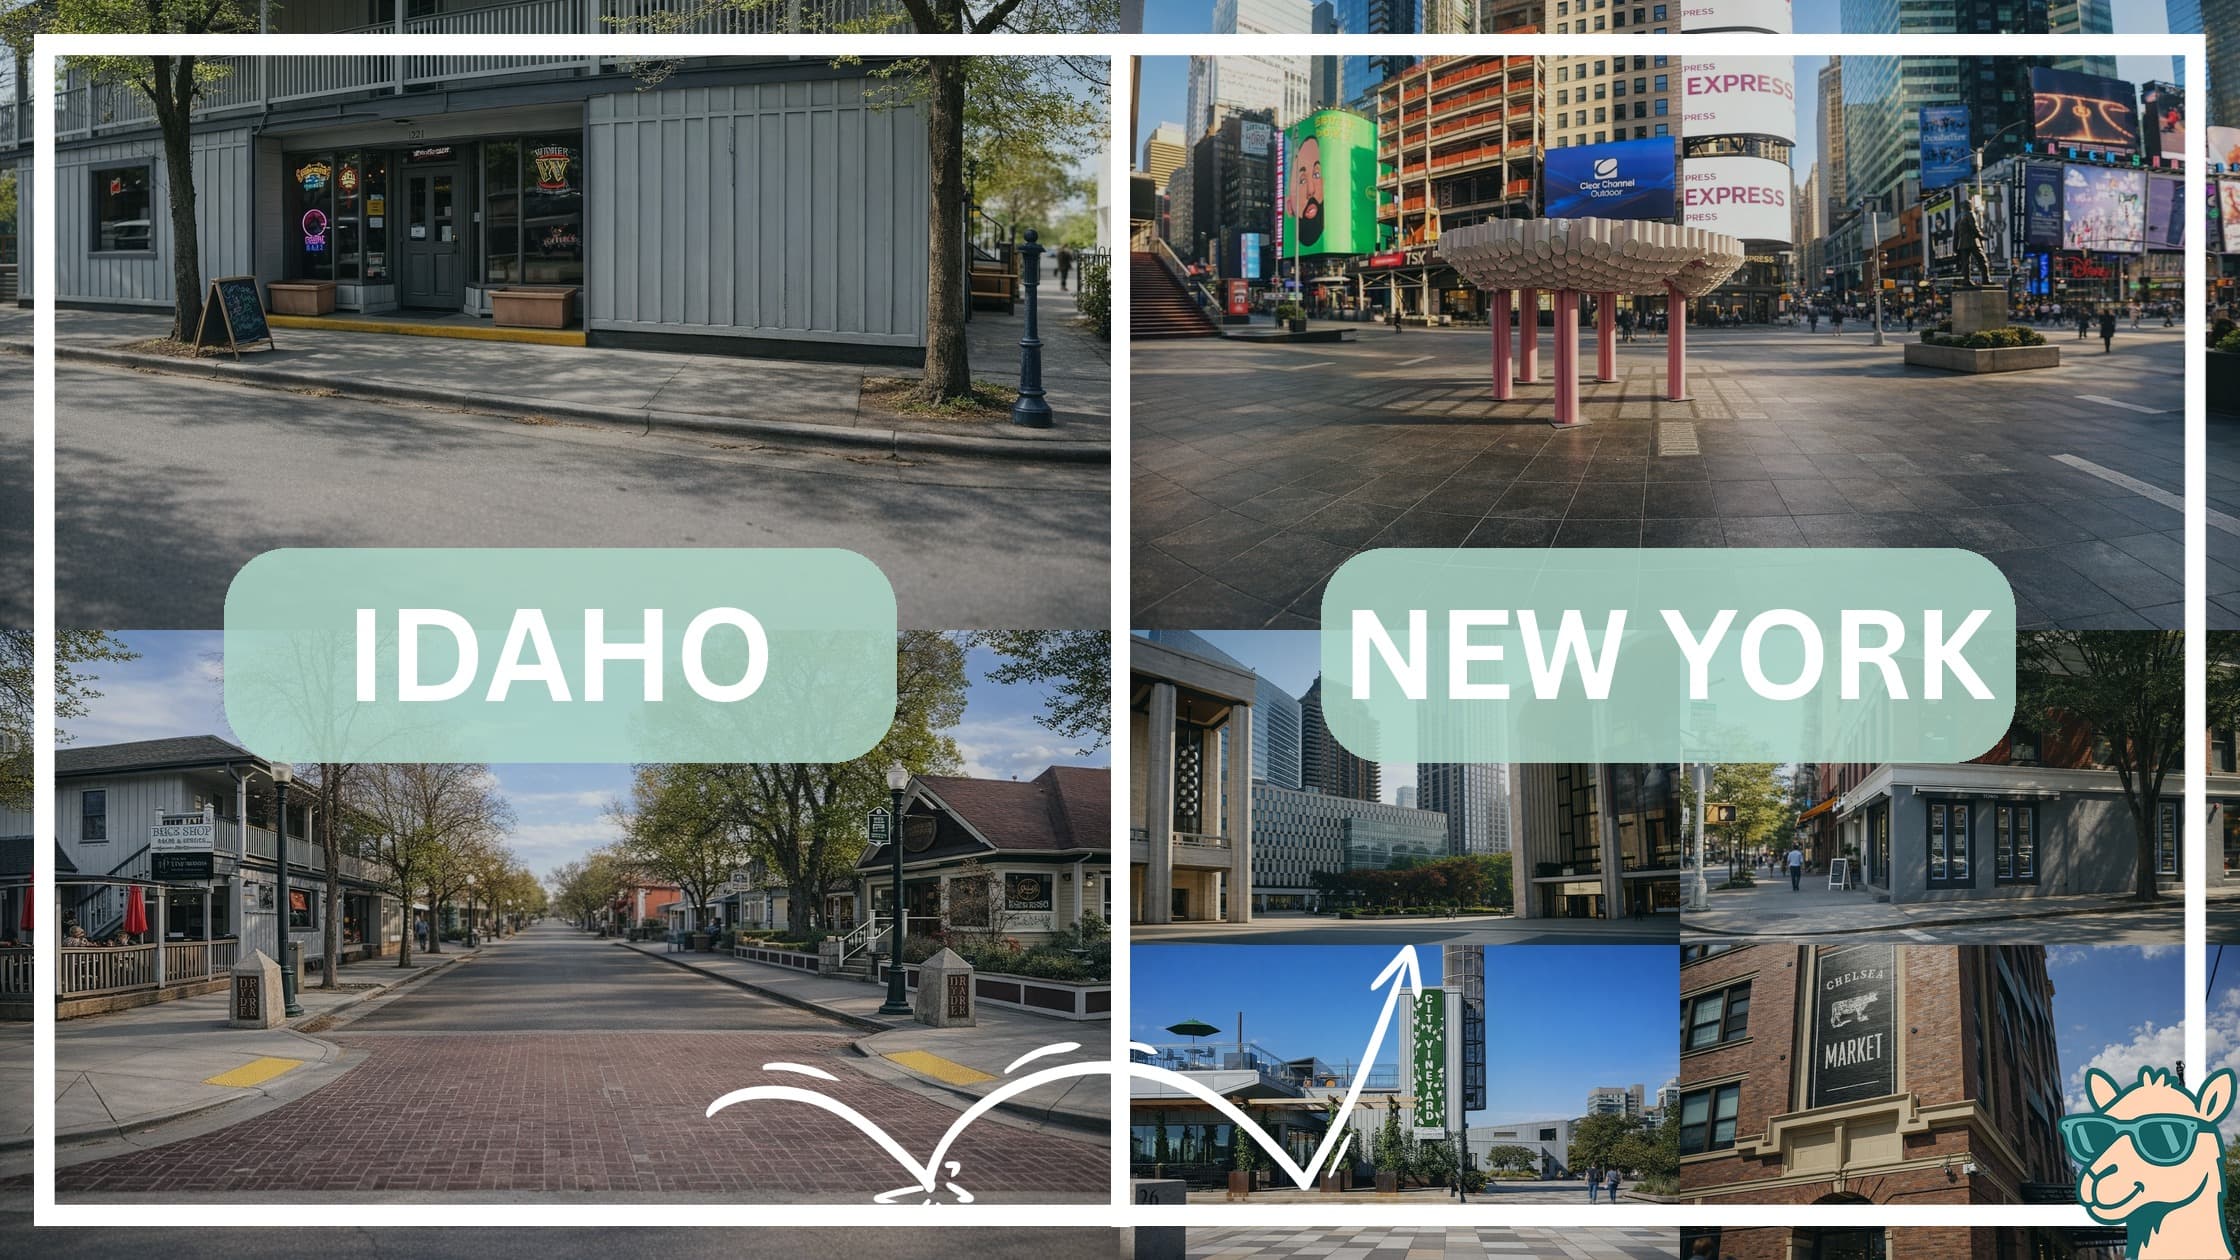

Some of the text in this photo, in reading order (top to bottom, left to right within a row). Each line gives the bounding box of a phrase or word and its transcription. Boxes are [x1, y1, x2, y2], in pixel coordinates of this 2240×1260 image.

[1681, 8, 1714, 16] PRESS
[1687, 74, 1793, 100] EXPRESS
[1580, 178, 1635, 190] Clear Channel
[1685, 173, 1717, 181] PRESS
[1591, 189, 1623, 198] Outdoor
[1685, 186, 1785, 207] EXPRESS
[1686, 213, 1718, 221] PRESS
[1826, 969, 1883, 990] CHELSEA
[1424, 994, 1434, 1121] CITY VINEYARD
[1825, 1033, 1883, 1070] MARKET
